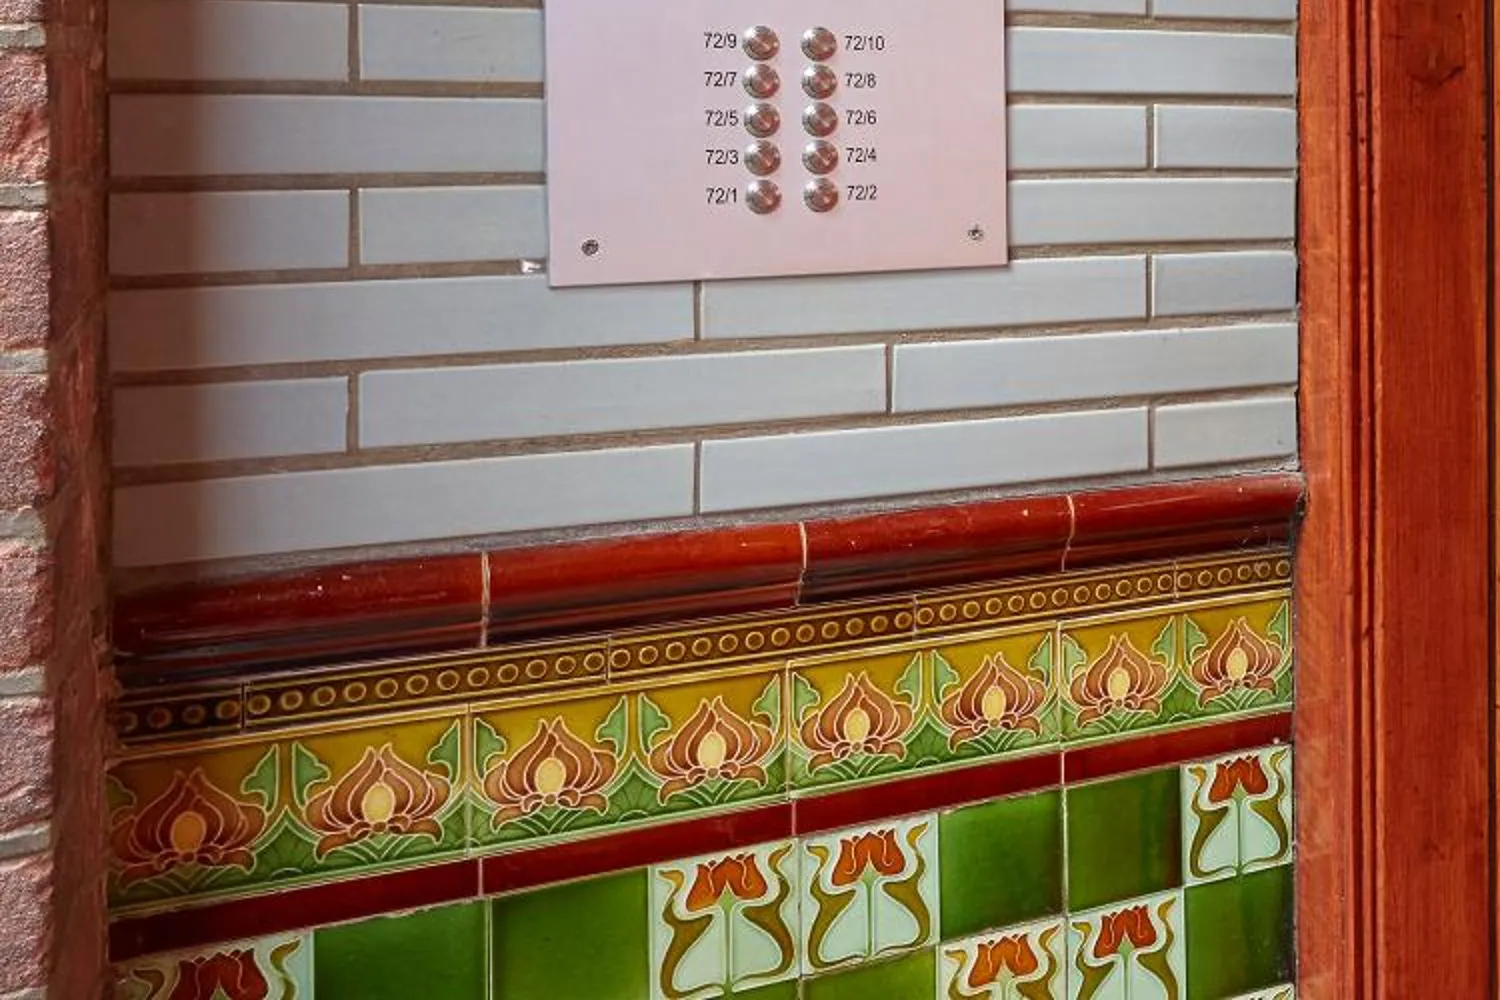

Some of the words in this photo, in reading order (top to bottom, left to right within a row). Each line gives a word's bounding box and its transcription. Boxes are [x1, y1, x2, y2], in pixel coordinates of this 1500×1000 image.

[704, 32, 737, 49] 72/9
[844, 35, 885, 51] 72/10
[704, 71, 737, 87] 72/7
[845, 73, 877, 89] 72/8
[705, 110, 739, 127] 72/5
[846, 110, 877, 126] 72/6
[705, 149, 739, 165] 72/3
[846, 147, 877, 163] 72/4
[706, 187, 738, 204] 72/1
[847, 184, 877, 201] 72/2
